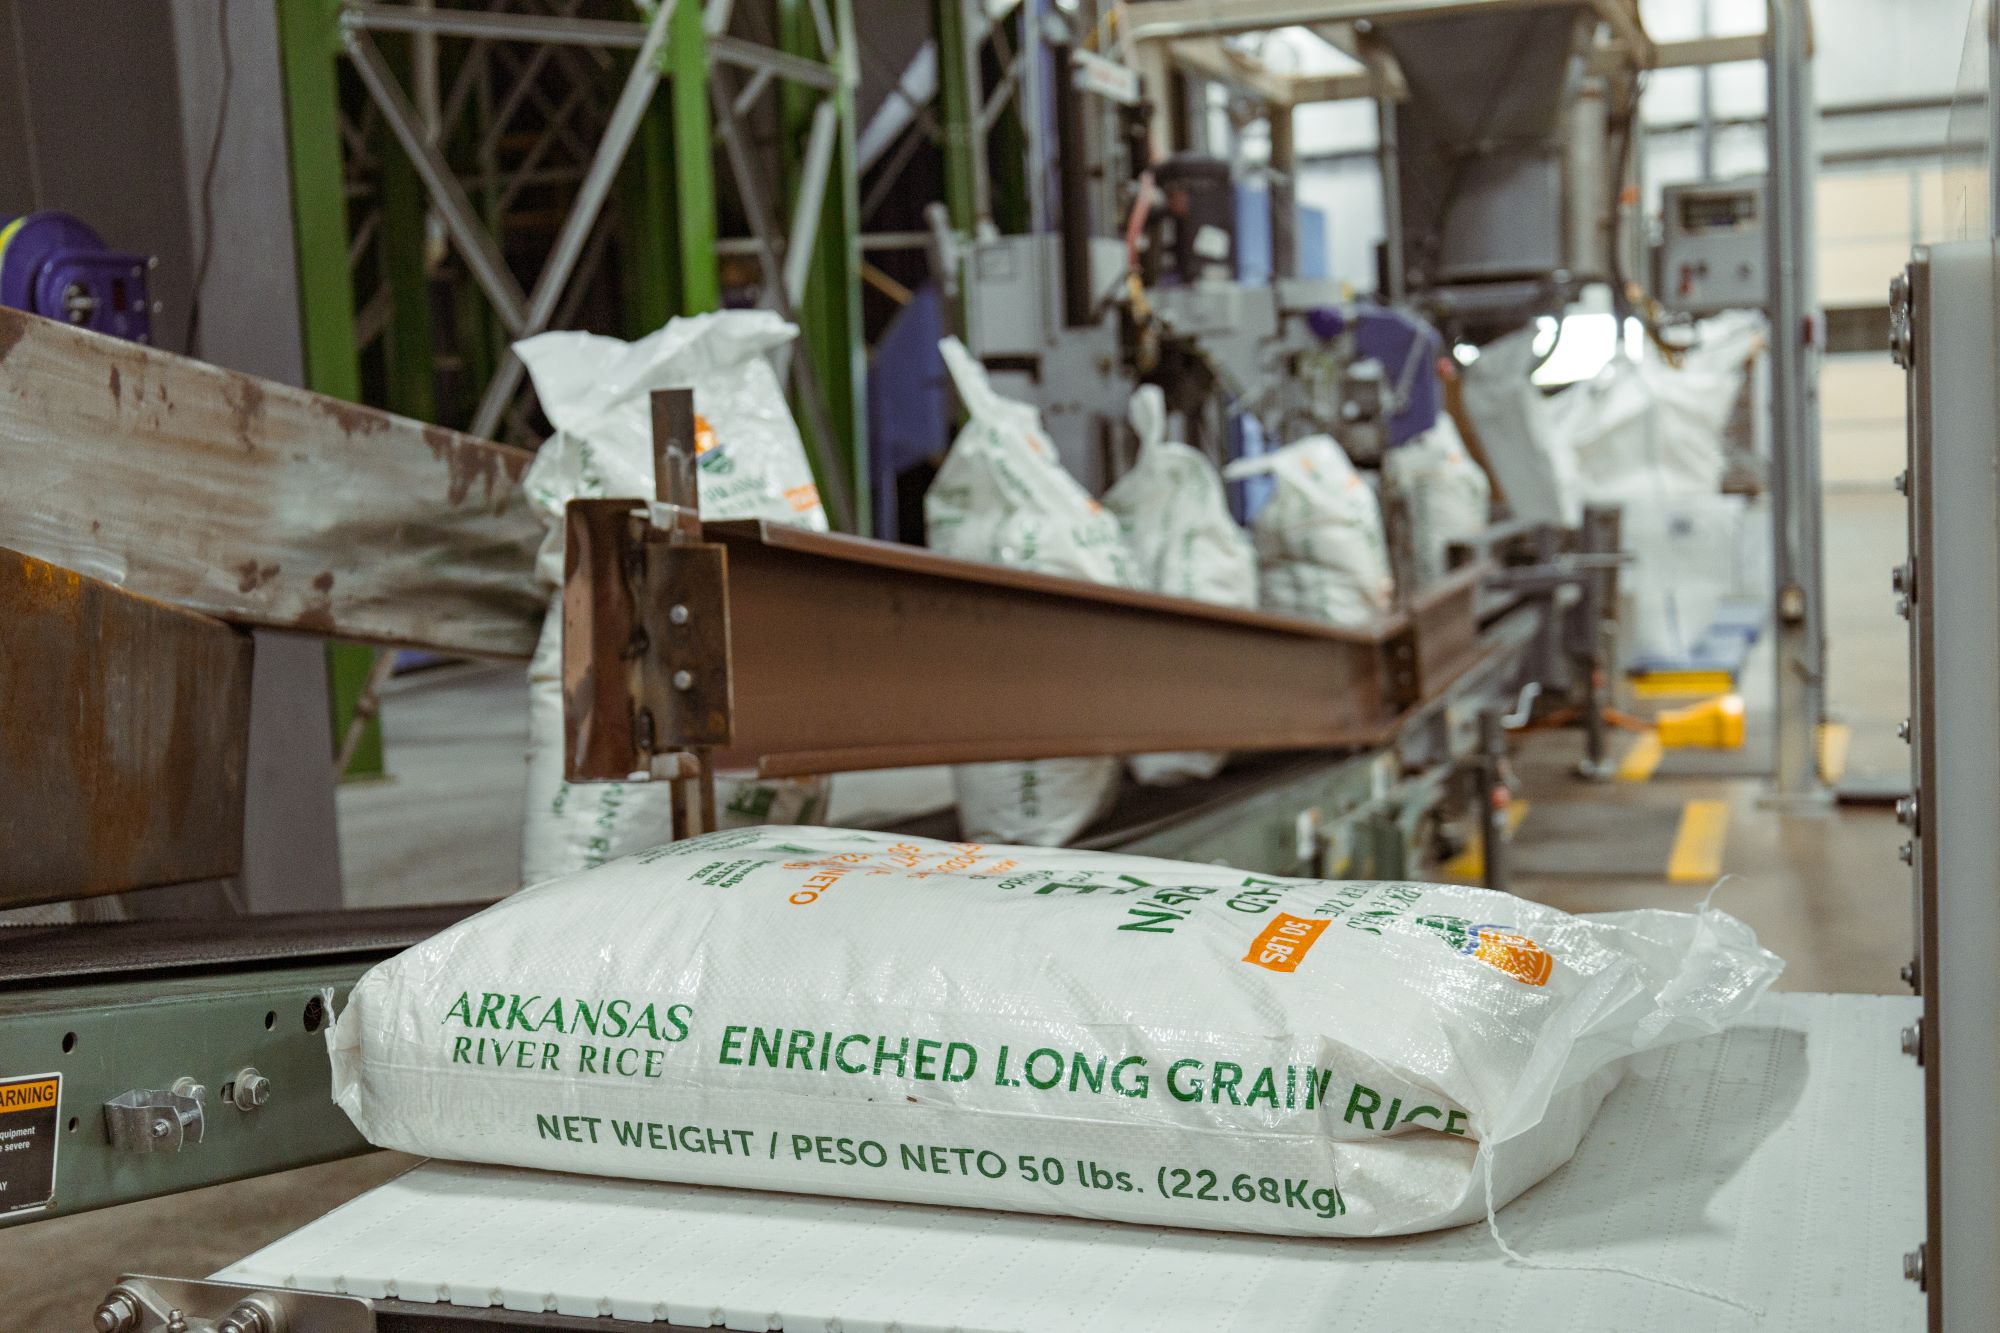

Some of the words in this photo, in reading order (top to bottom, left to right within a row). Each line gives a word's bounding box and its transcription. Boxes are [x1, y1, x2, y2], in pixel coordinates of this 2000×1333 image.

[1259, 935, 1301, 963] LBS
[1279, 920, 1313, 936] 50
[441, 990, 694, 1043] ARKANSAS
[452, 1035, 560, 1071] RIVER
[578, 1042, 665, 1078] RICE
[718, 1023, 978, 1084] ENRICHED
[994, 1043, 1150, 1100] LONG
[1165, 1057, 1332, 1113] GRAIN
[4, 1140, 30, 1152] severe
[536, 1113, 601, 1145] NET
[611, 1119, 754, 1157] WEIGHT
[768, 1131, 778, 1160] /
[792, 1134, 888, 1168] PESO
[900, 1142, 1008, 1179] NETO
[1017, 1155, 1065, 1186] 50
[1077, 1160, 1145, 1193] lbs.
